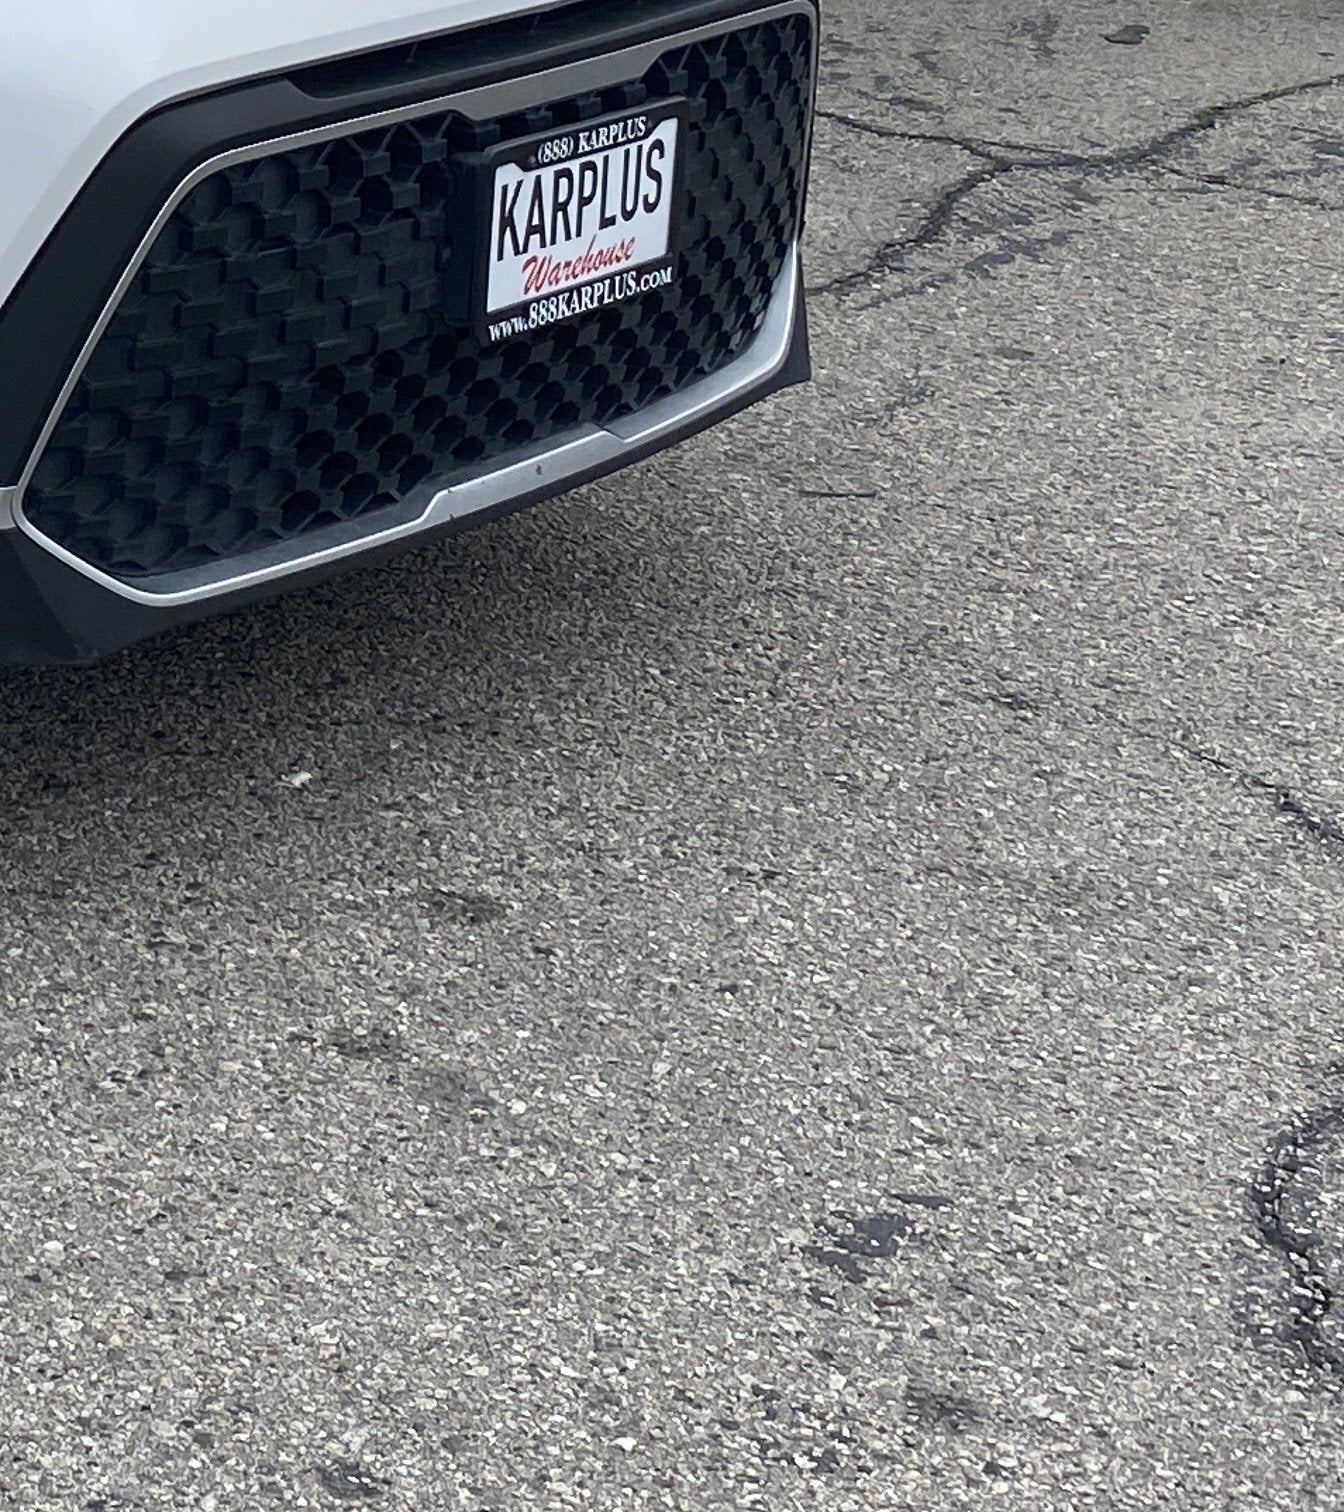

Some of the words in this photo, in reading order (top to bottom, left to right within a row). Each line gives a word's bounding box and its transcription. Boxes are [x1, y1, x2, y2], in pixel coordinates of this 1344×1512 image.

[537, 136, 575, 165] (888)
[577, 115, 648, 154] KARPLUS
[496, 137, 666, 263] KARPLUS
[521, 233, 636, 296] Warehouse
